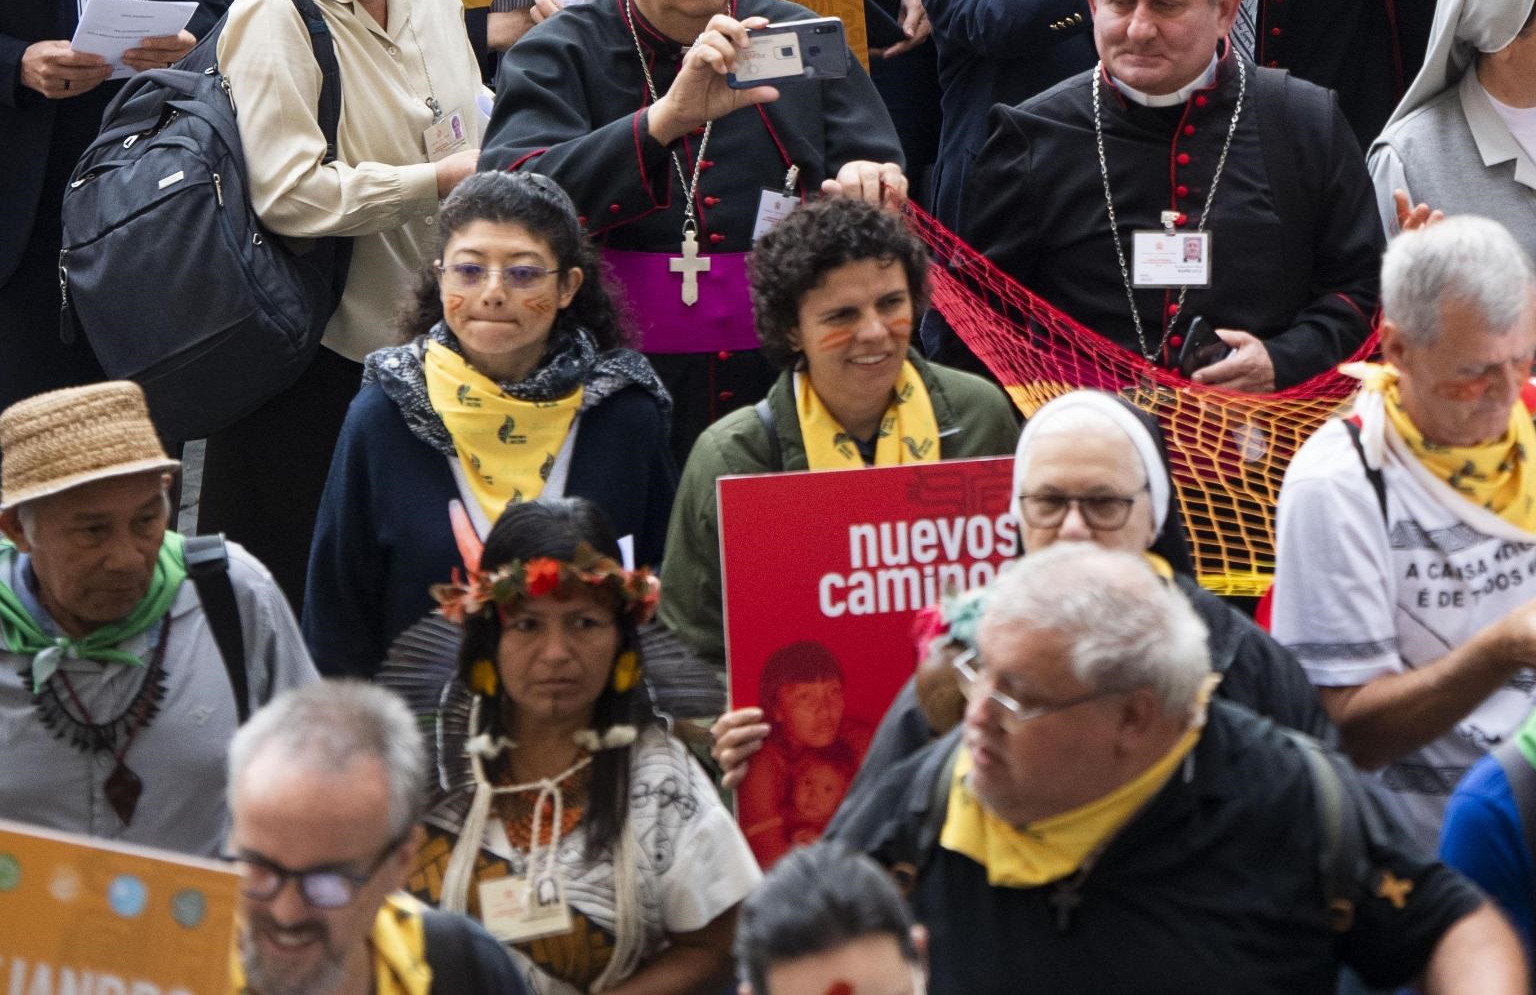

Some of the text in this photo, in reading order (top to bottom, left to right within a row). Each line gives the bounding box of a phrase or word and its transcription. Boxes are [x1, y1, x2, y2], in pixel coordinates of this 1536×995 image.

[849, 511, 1018, 569] nuevos
[1405, 563, 1419, 579] A
[1438, 591, 1464, 608] DE
